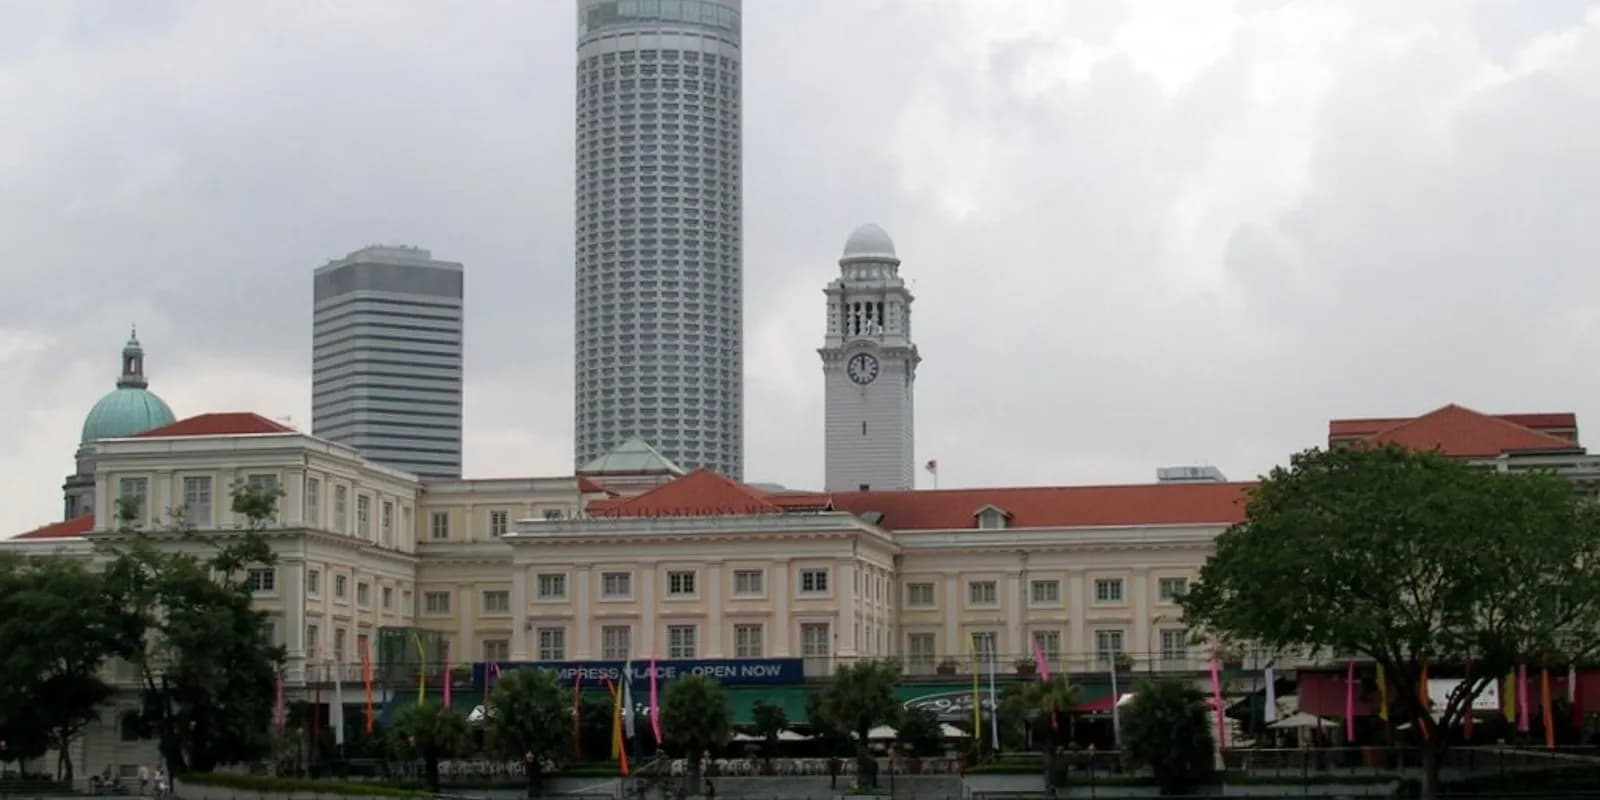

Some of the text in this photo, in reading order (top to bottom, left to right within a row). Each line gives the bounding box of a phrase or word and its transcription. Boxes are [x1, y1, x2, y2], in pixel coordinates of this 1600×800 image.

[546, 667, 619, 680] MPRESS
[623, 666, 676, 679] LACE
[692, 665, 737, 678] OPEN
[741, 664, 782, 677] NOW
